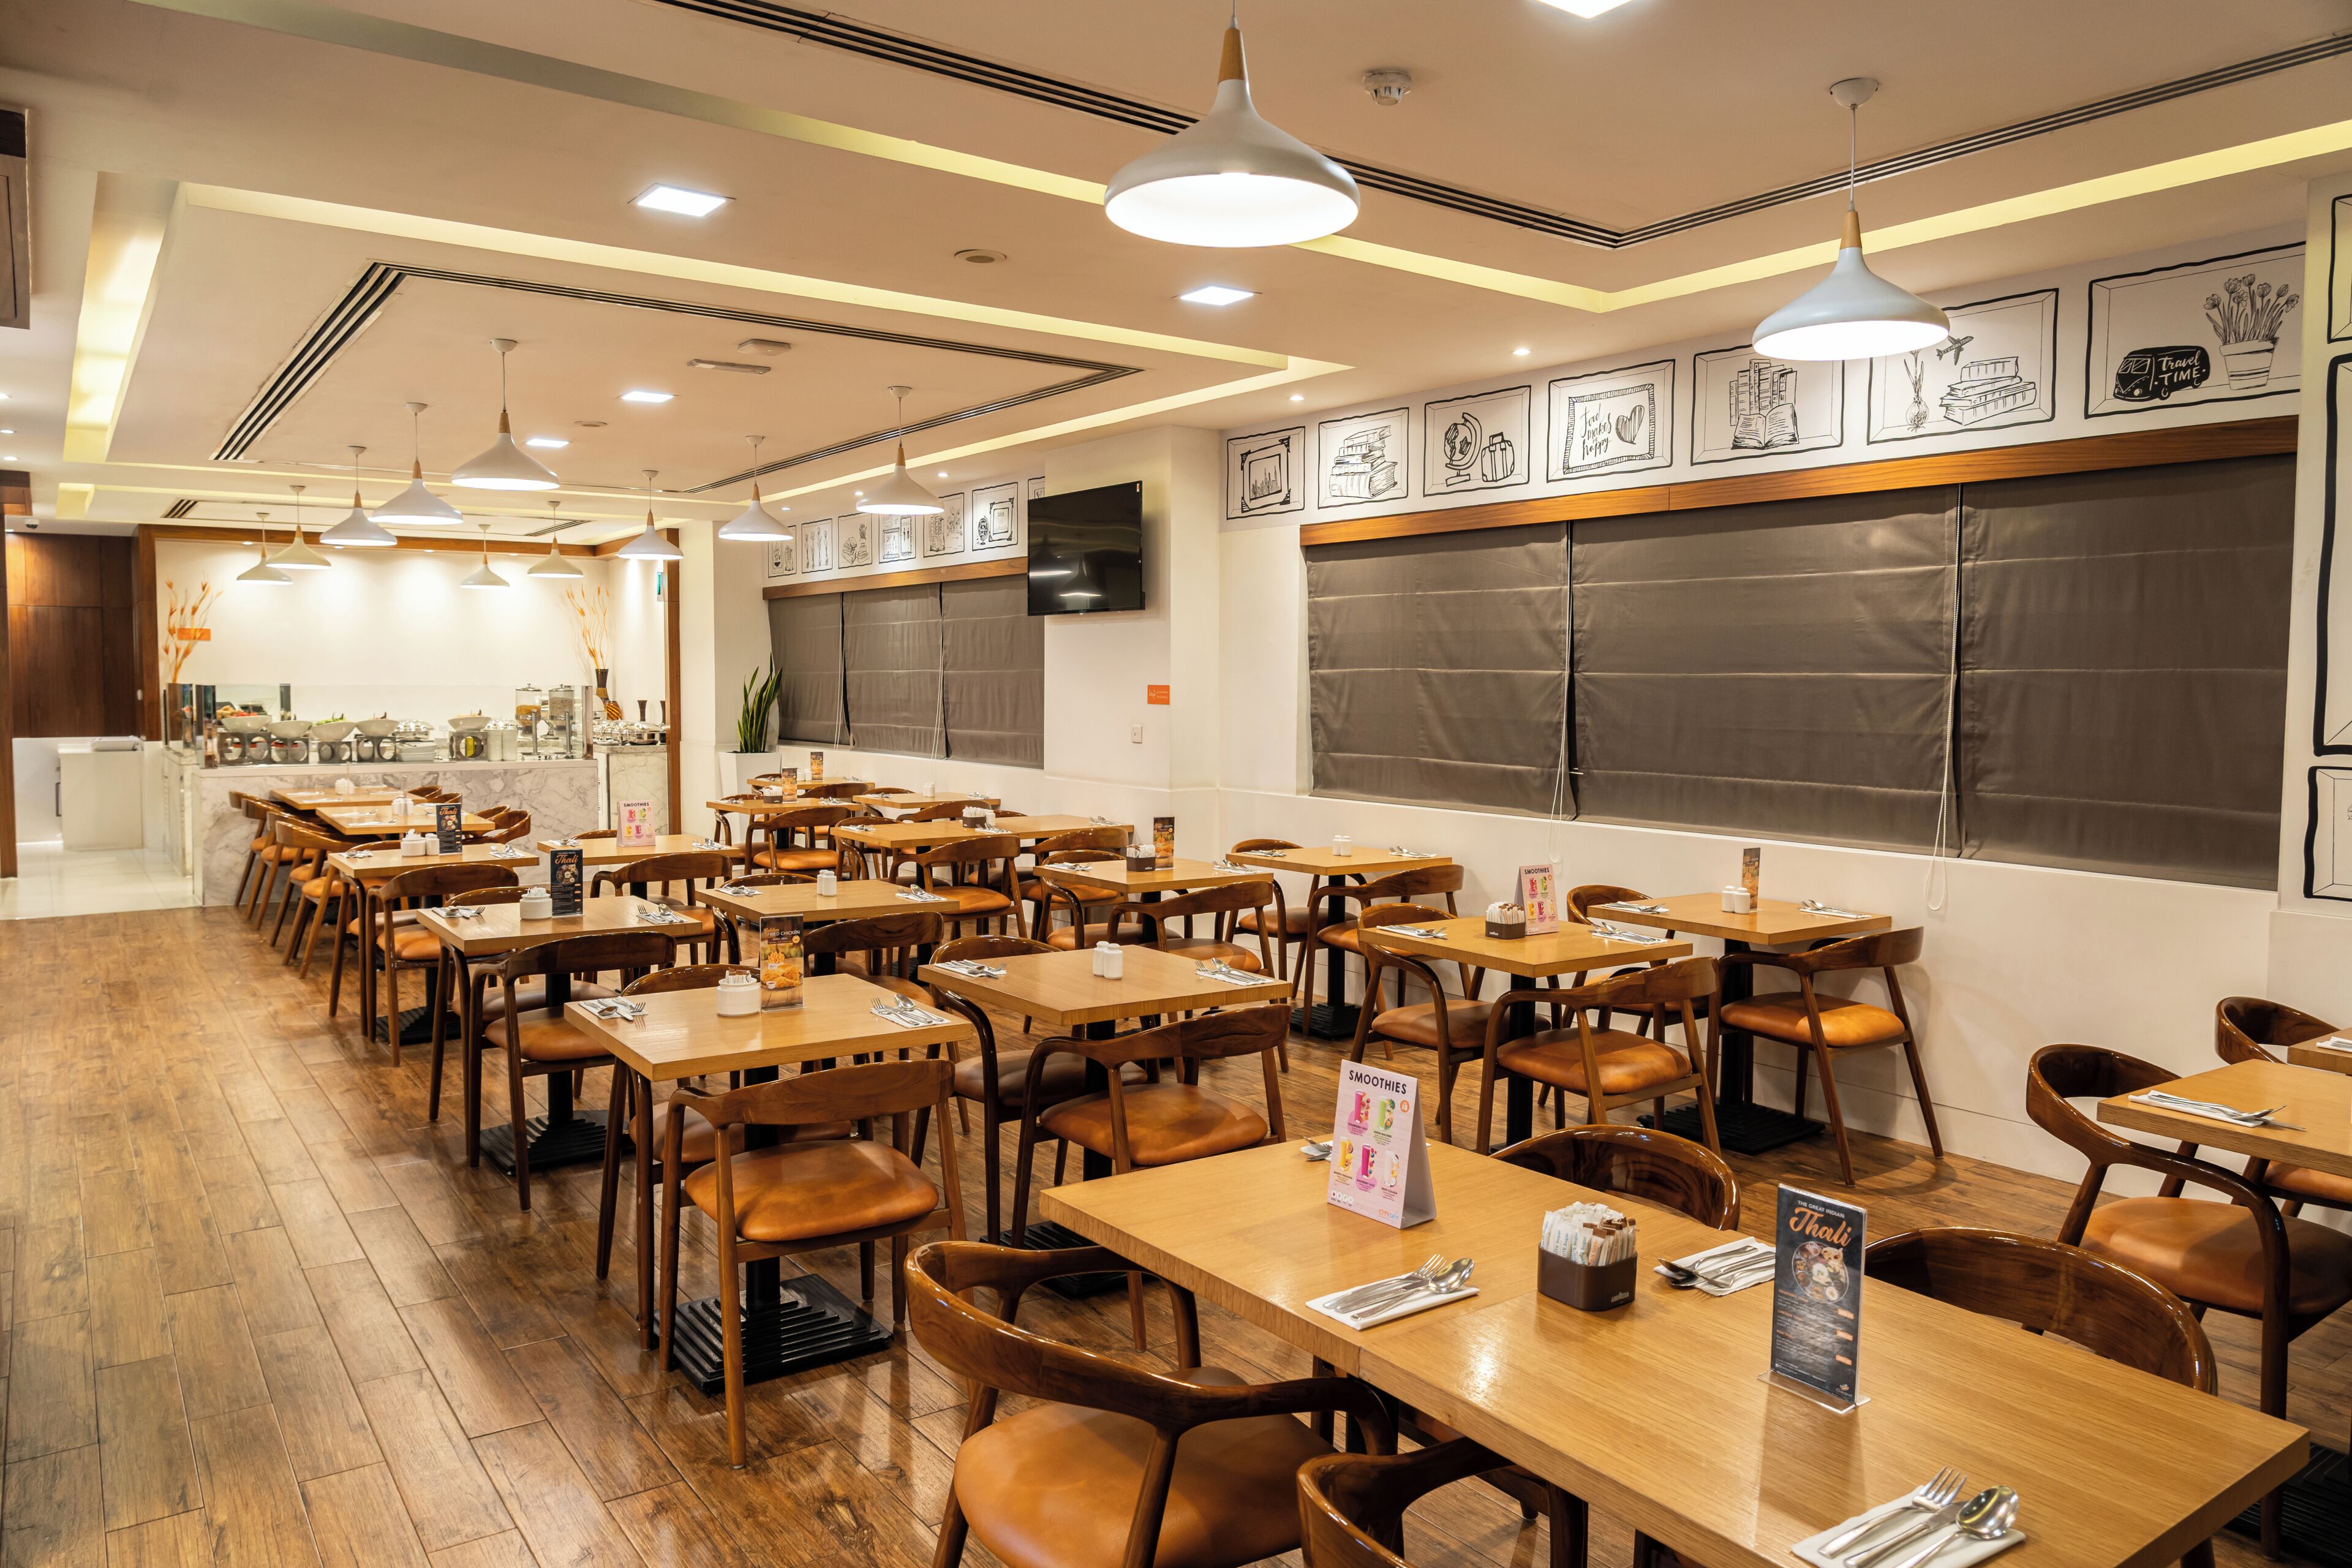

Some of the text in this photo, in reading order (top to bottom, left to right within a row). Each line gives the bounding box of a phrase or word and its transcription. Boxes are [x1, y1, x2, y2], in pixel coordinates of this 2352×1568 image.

[2158, 366, 2200, 385] TIME
[1588, 412, 1611, 440] makes
[1583, 437, 1611, 461] happy
[555, 854, 578, 864] Thali
[1349, 1070, 1407, 1095] SMOOTHIES
[1808, 1203, 1825, 1212] GREAT
[1825, 1208, 1845, 1218] INDIAN
[1789, 1207, 1852, 1247] Thali
